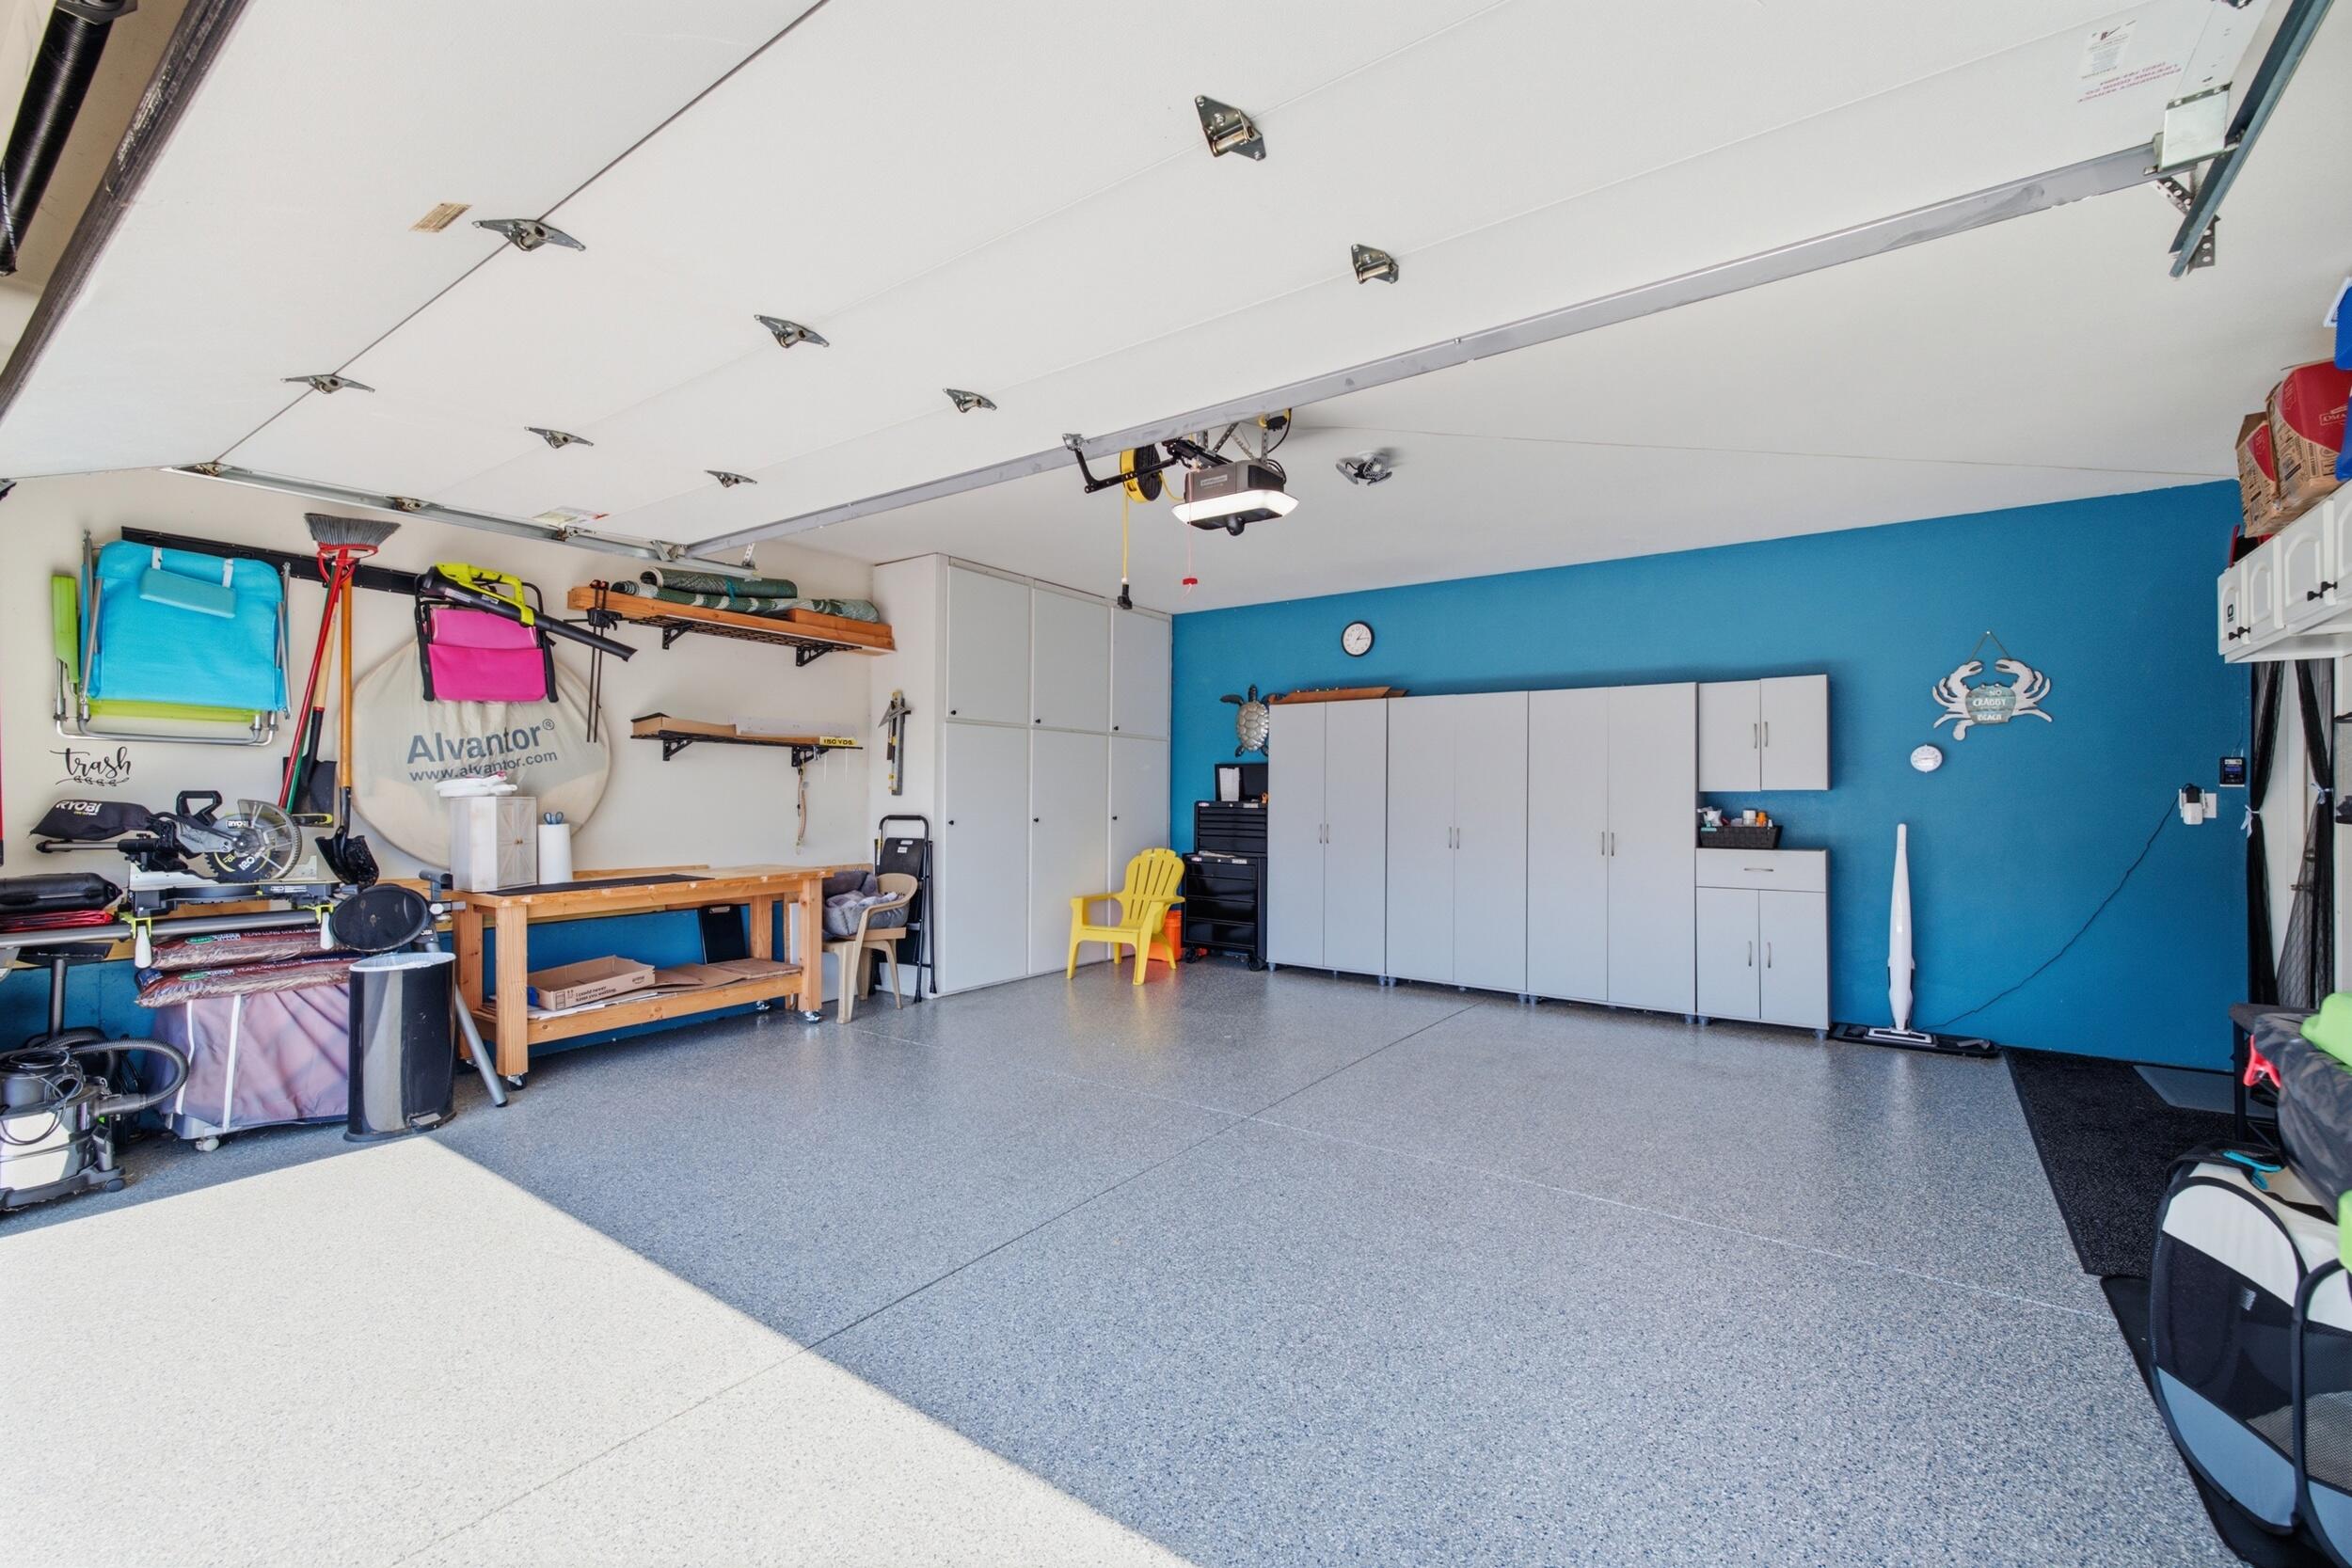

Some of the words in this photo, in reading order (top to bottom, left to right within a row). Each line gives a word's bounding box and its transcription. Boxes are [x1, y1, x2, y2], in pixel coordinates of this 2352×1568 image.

[50, 747, 131, 779] trash
[410, 752, 558, 782] www.alvantor.com
[56, 800, 102, 814] RYOBI
